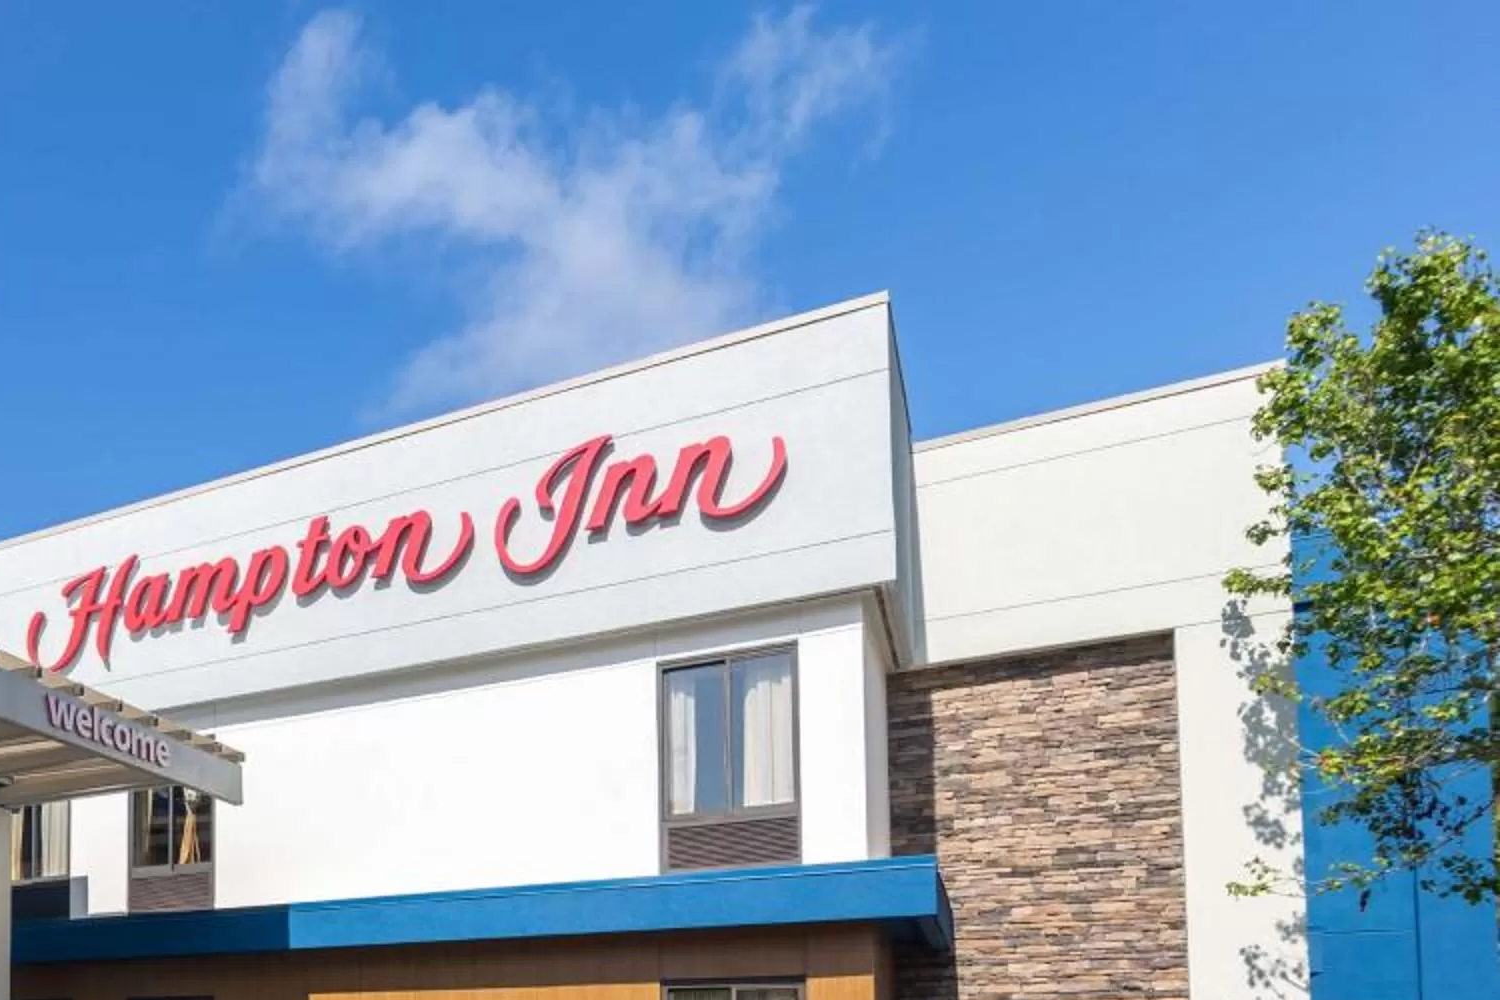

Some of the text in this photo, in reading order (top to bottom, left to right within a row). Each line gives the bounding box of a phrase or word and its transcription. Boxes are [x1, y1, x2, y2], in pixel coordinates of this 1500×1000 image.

[26, 434, 787, 673] Hampton Inn
[46, 693, 171, 768] welcome
